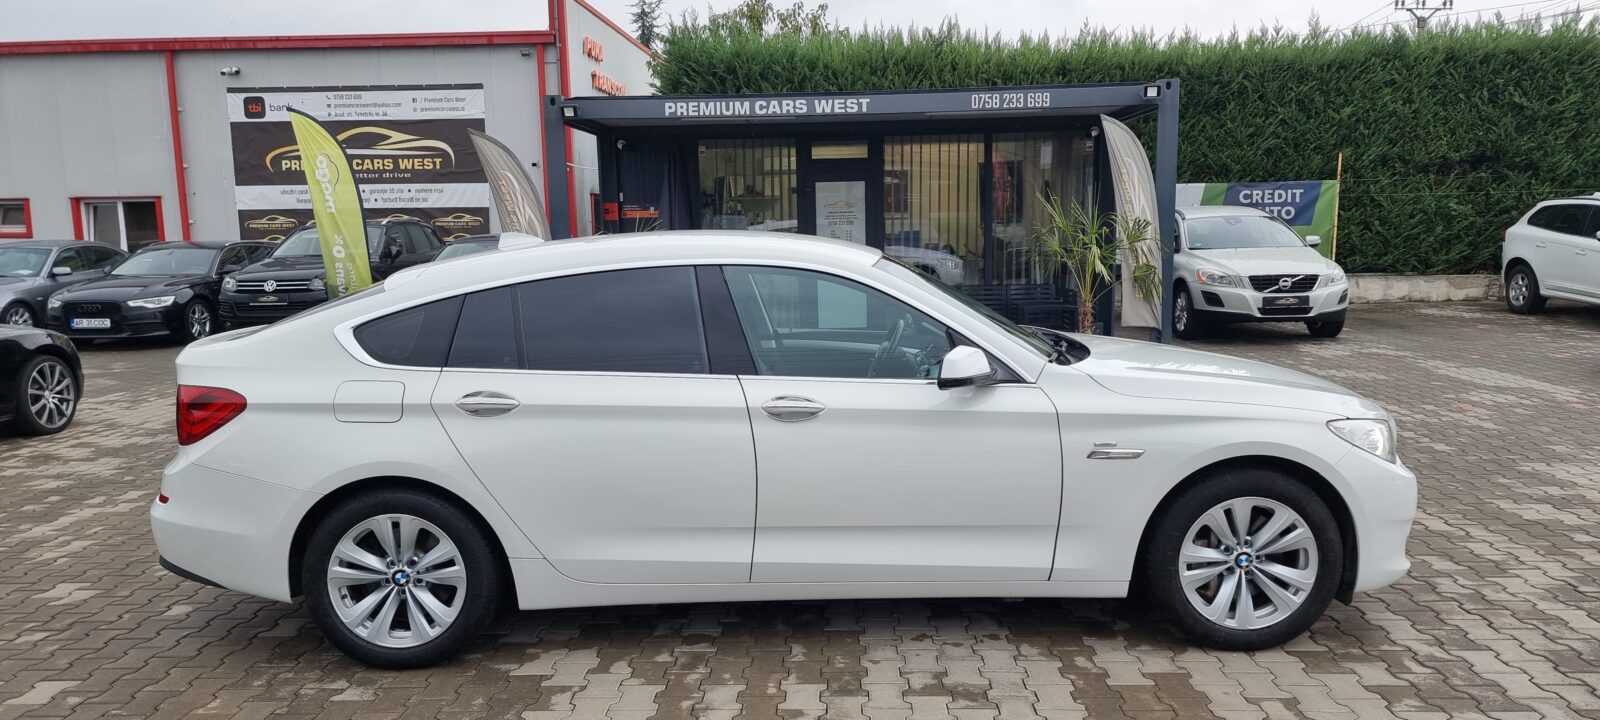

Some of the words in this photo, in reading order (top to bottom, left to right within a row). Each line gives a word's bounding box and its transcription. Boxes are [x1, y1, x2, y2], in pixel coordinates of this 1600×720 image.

[664, 101, 750, 116] PREMIUM
[755, 99, 807, 115] CARS
[814, 98, 870, 113] WEST
[971, 94, 1000, 108] 0758
[1003, 93, 1024, 107] 233
[1027, 92, 1050, 107] 699
[248, 103, 262, 112] tbi
[353, 158, 394, 170] CARS
[399, 158, 442, 169] WEST
[1239, 189, 1304, 203] CREDIT
[1258, 206, 1295, 220] TO
